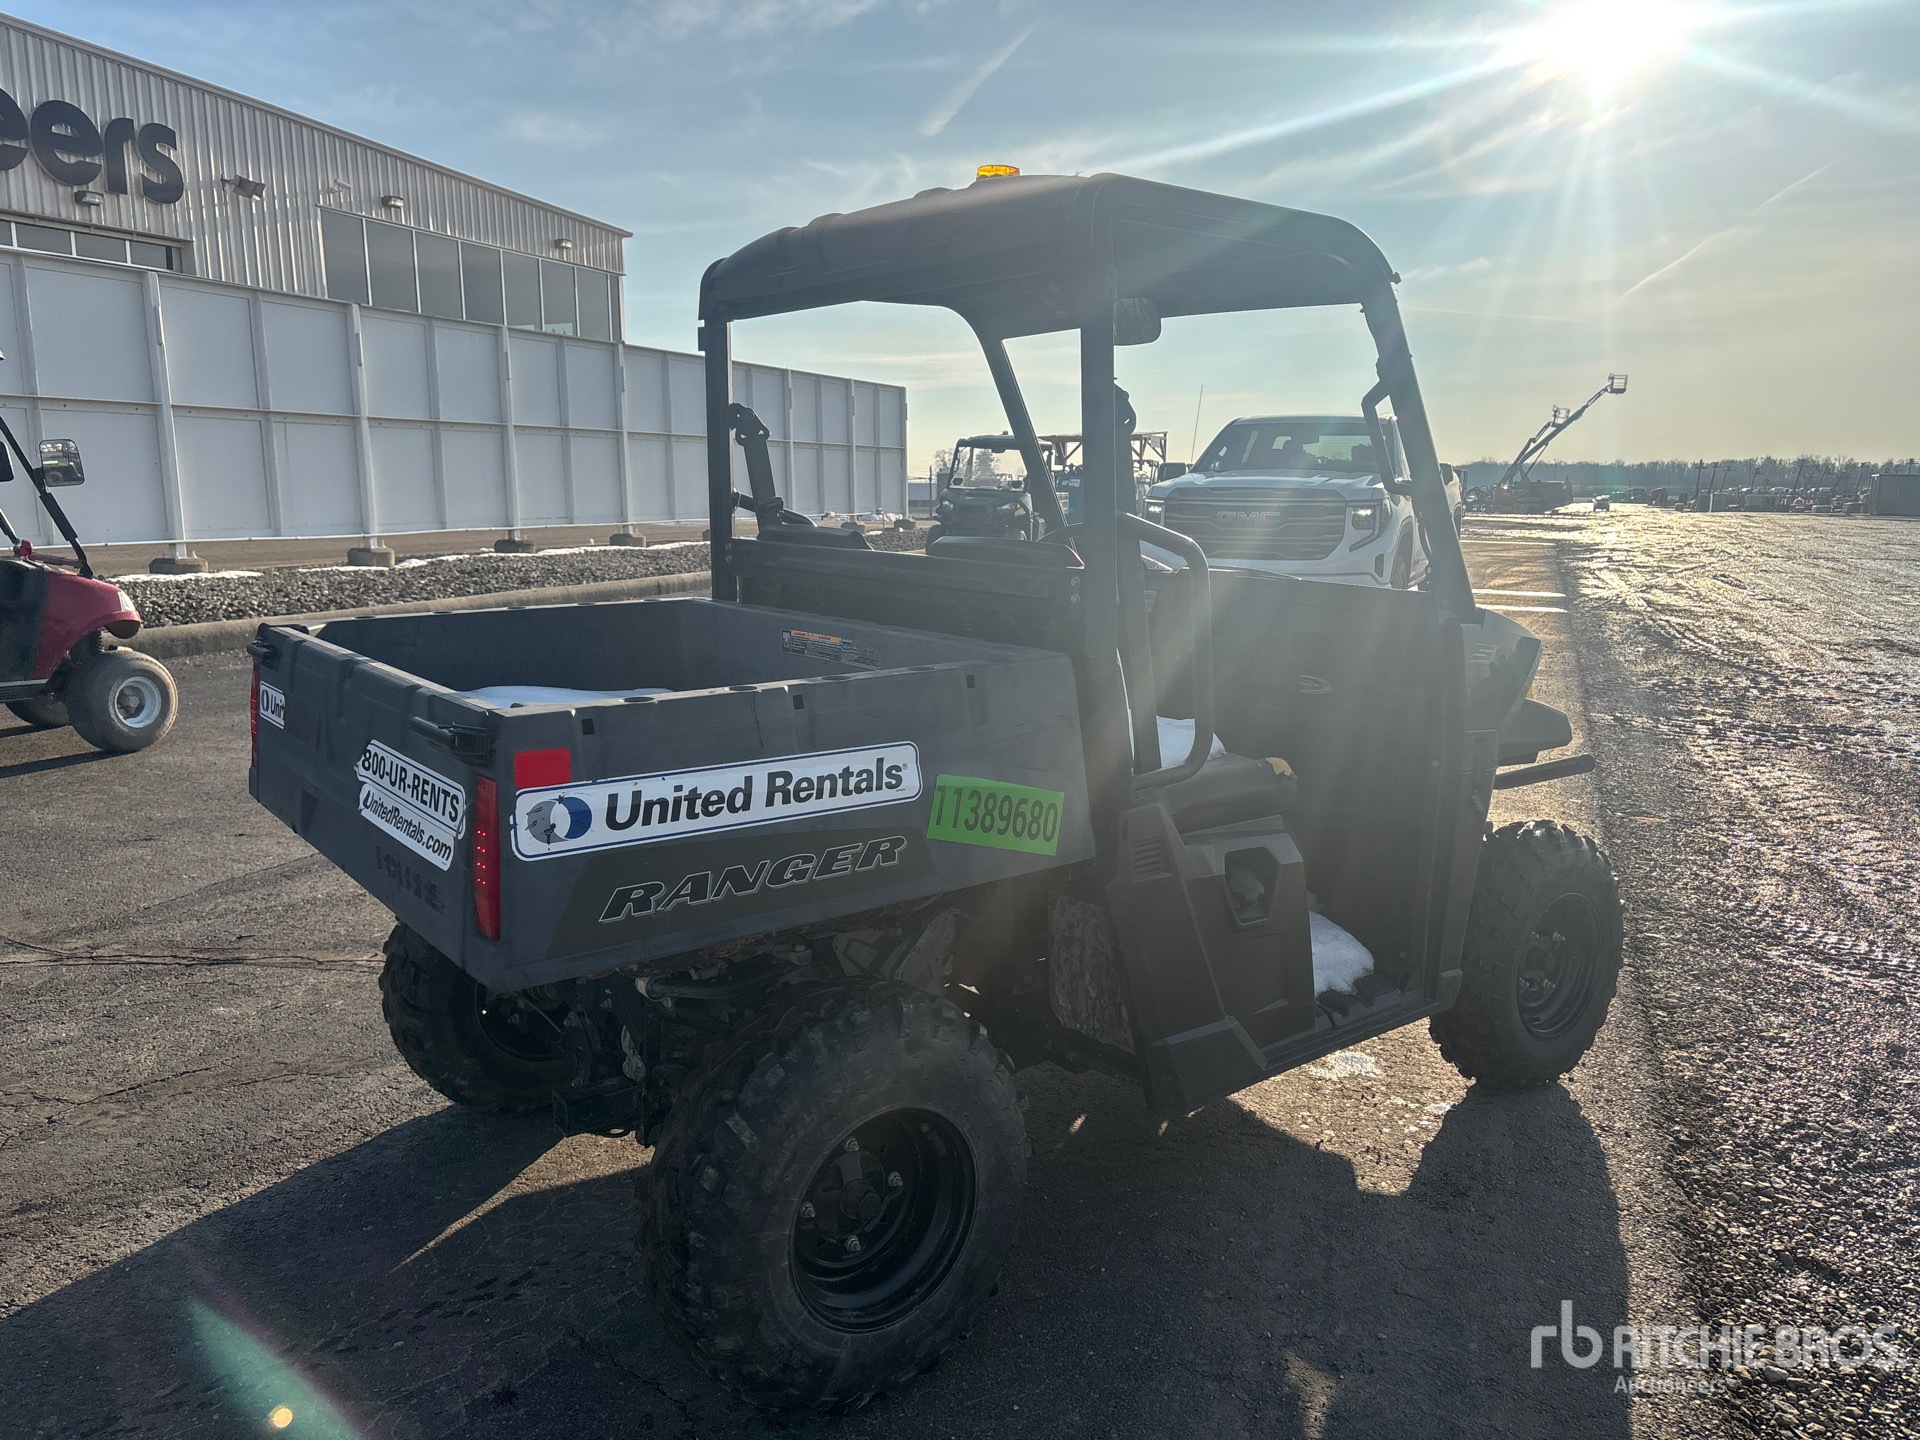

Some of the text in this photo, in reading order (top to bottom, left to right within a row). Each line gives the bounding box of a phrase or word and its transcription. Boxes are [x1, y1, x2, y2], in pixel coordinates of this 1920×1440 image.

[1217, 511, 1280, 524] GMC
[361, 748, 460, 823] 800-UR-RENTS
[605, 758, 903, 831] United Rentals
[935, 785, 1059, 843] 11389680
[362, 789, 452, 861] UnitedRentals.com
[599, 835, 908, 923] RANGER
